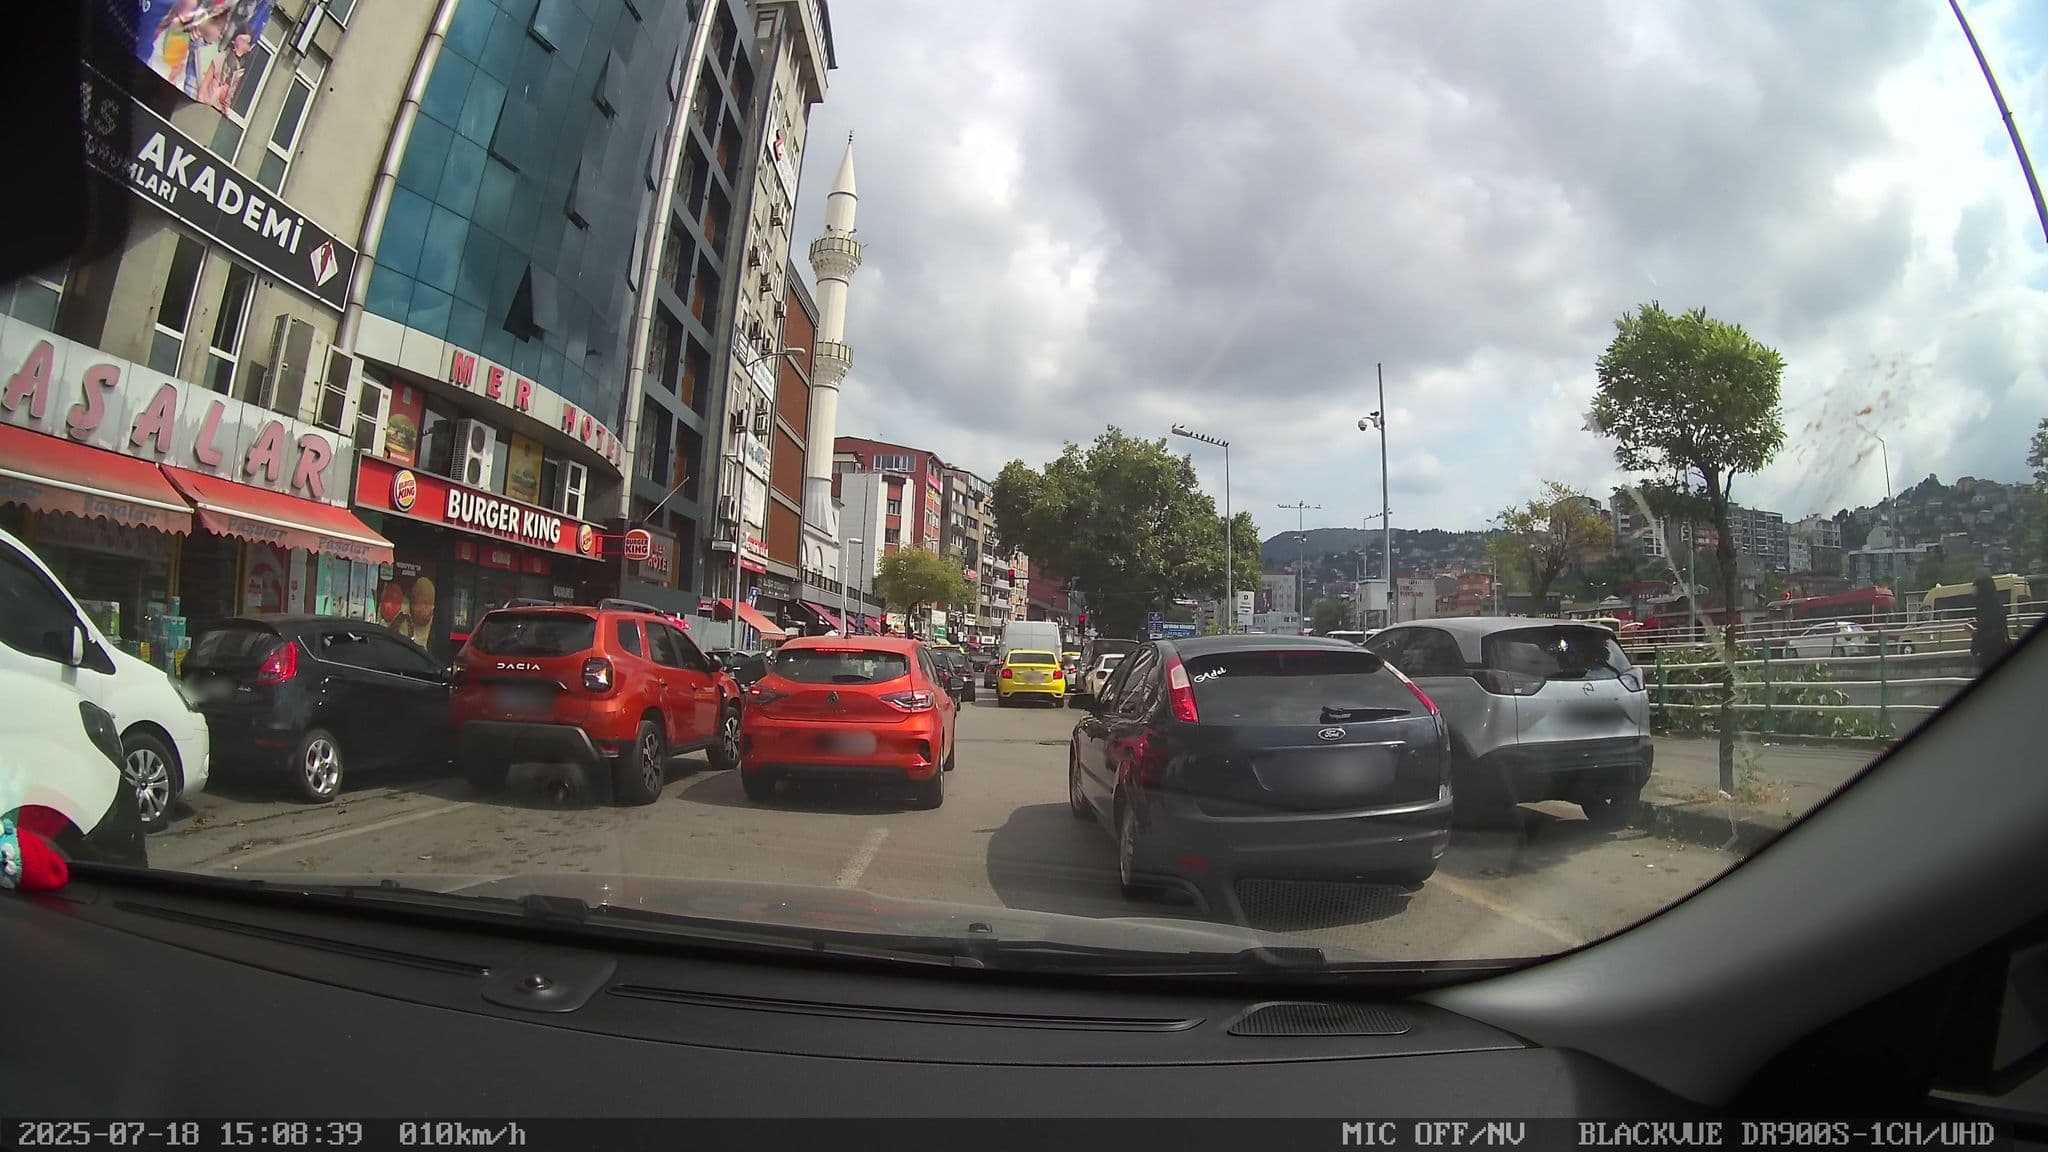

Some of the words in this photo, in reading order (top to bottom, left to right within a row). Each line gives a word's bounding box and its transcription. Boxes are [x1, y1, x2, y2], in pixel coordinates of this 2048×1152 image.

[137, 131, 305, 256] AKADEMİ
[450, 349, 533, 412] MER
[447, 488, 519, 534] BURGER
[522, 508, 561, 544] KING
[625, 545, 648, 554] KING
[496, 662, 541, 671] DACIA
